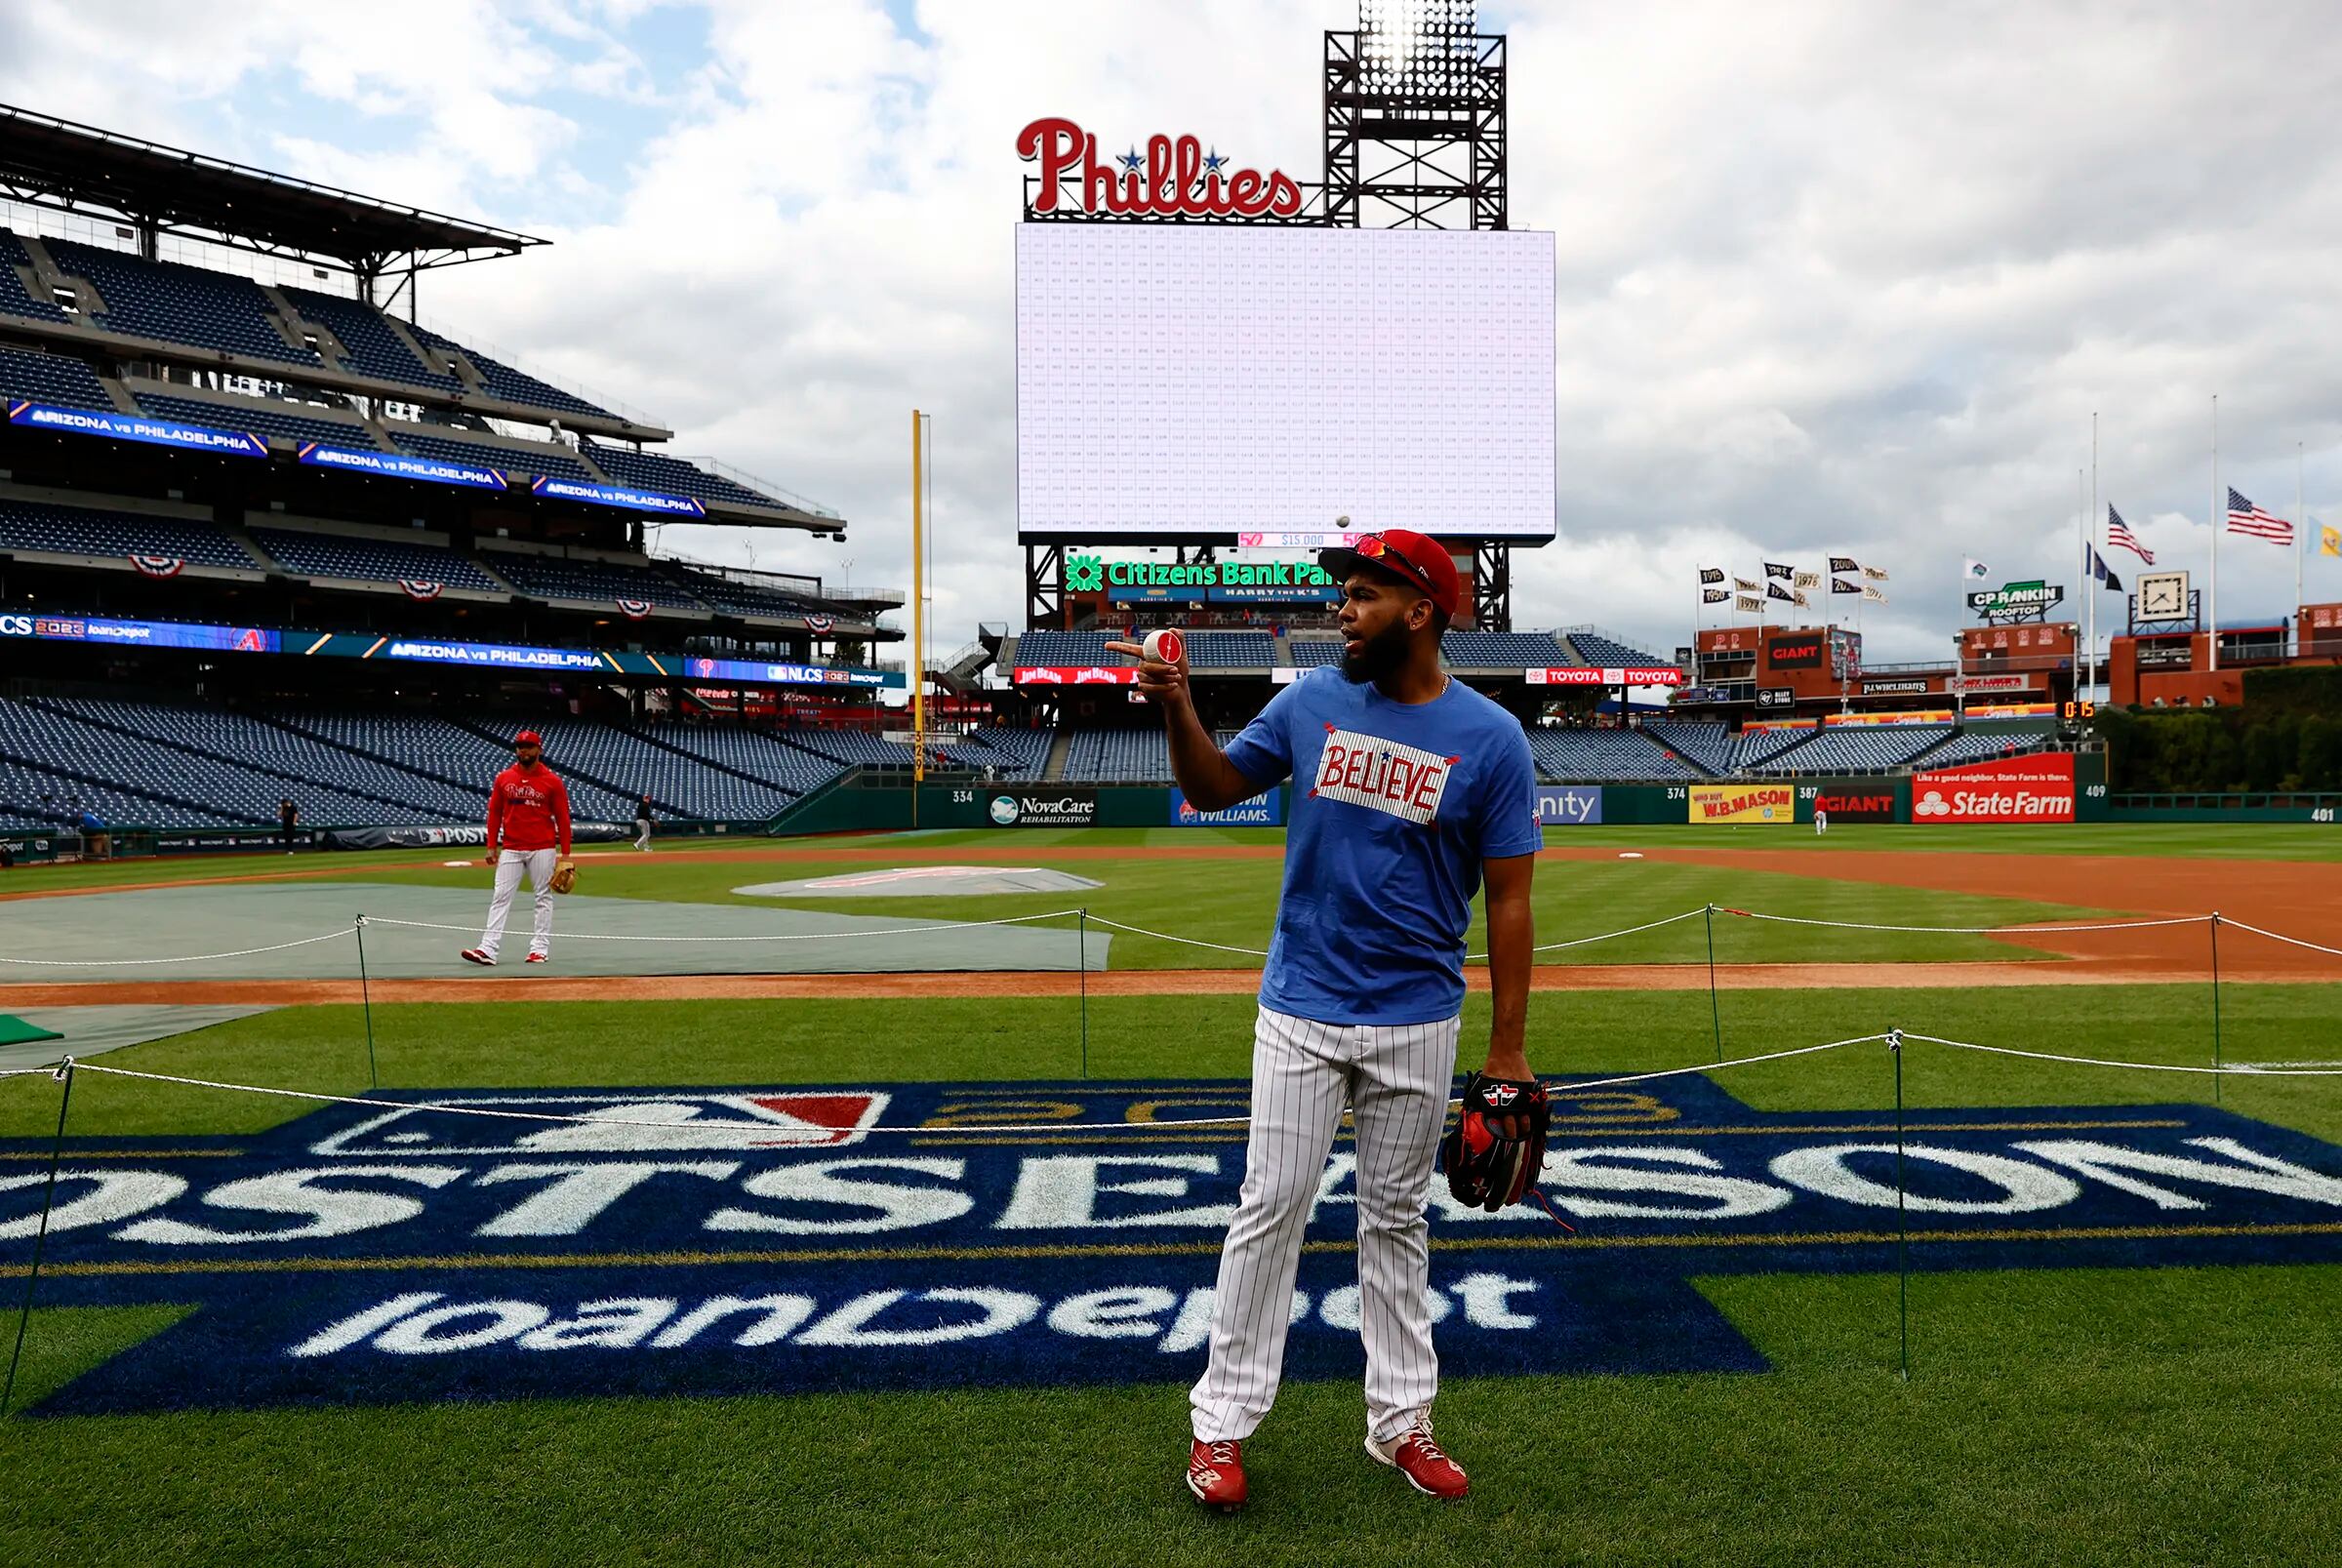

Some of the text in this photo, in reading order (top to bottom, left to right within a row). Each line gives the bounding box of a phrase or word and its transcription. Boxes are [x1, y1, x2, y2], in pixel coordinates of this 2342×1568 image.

[1016, 117, 1303, 216] Phillies
[32, 409, 111, 431] ARIZONA
[134, 423, 251, 452] PHILADELPHIA
[316, 450, 382, 469] ARIZONA
[398, 462, 493, 486] PHILADELPHIA
[546, 482, 600, 499] ARIZONA
[615, 492, 694, 512] PHILADELPHIA
[1109, 561, 1217, 585] Citizens
[1223, 561, 1289, 585] Bank
[1989, 606, 2041, 618] ROOFTOP
[35, 621, 85, 635] 2023
[390, 641, 468, 661] ARIZONA
[491, 649, 603, 669] PHILADELPHIA
[1772, 645, 1818, 661] GIANT
[788, 666, 824, 683] NLCS
[1020, 667, 1062, 684] JIM BEAM
[1074, 669, 1091, 684] JIM
[1092, 667, 1117, 684] BEAM
[1550, 670, 1600, 682] TOYOTA
[1628, 670, 1678, 682] TOYOTA
[2065, 701, 2095, 719] 0:15
[1941, 774, 1959, 784] good
[952, 790, 973, 803] 334
[1667, 786, 1685, 800] 374
[1799, 787, 1818, 799] 387
[2085, 784, 2106, 797] 409
[1020, 796, 1094, 814] NovaCare
[1827, 795, 1894, 812] GIANT
[1020, 814, 1092, 824] REHABILITATION
[2311, 808, 2334, 822] 401
